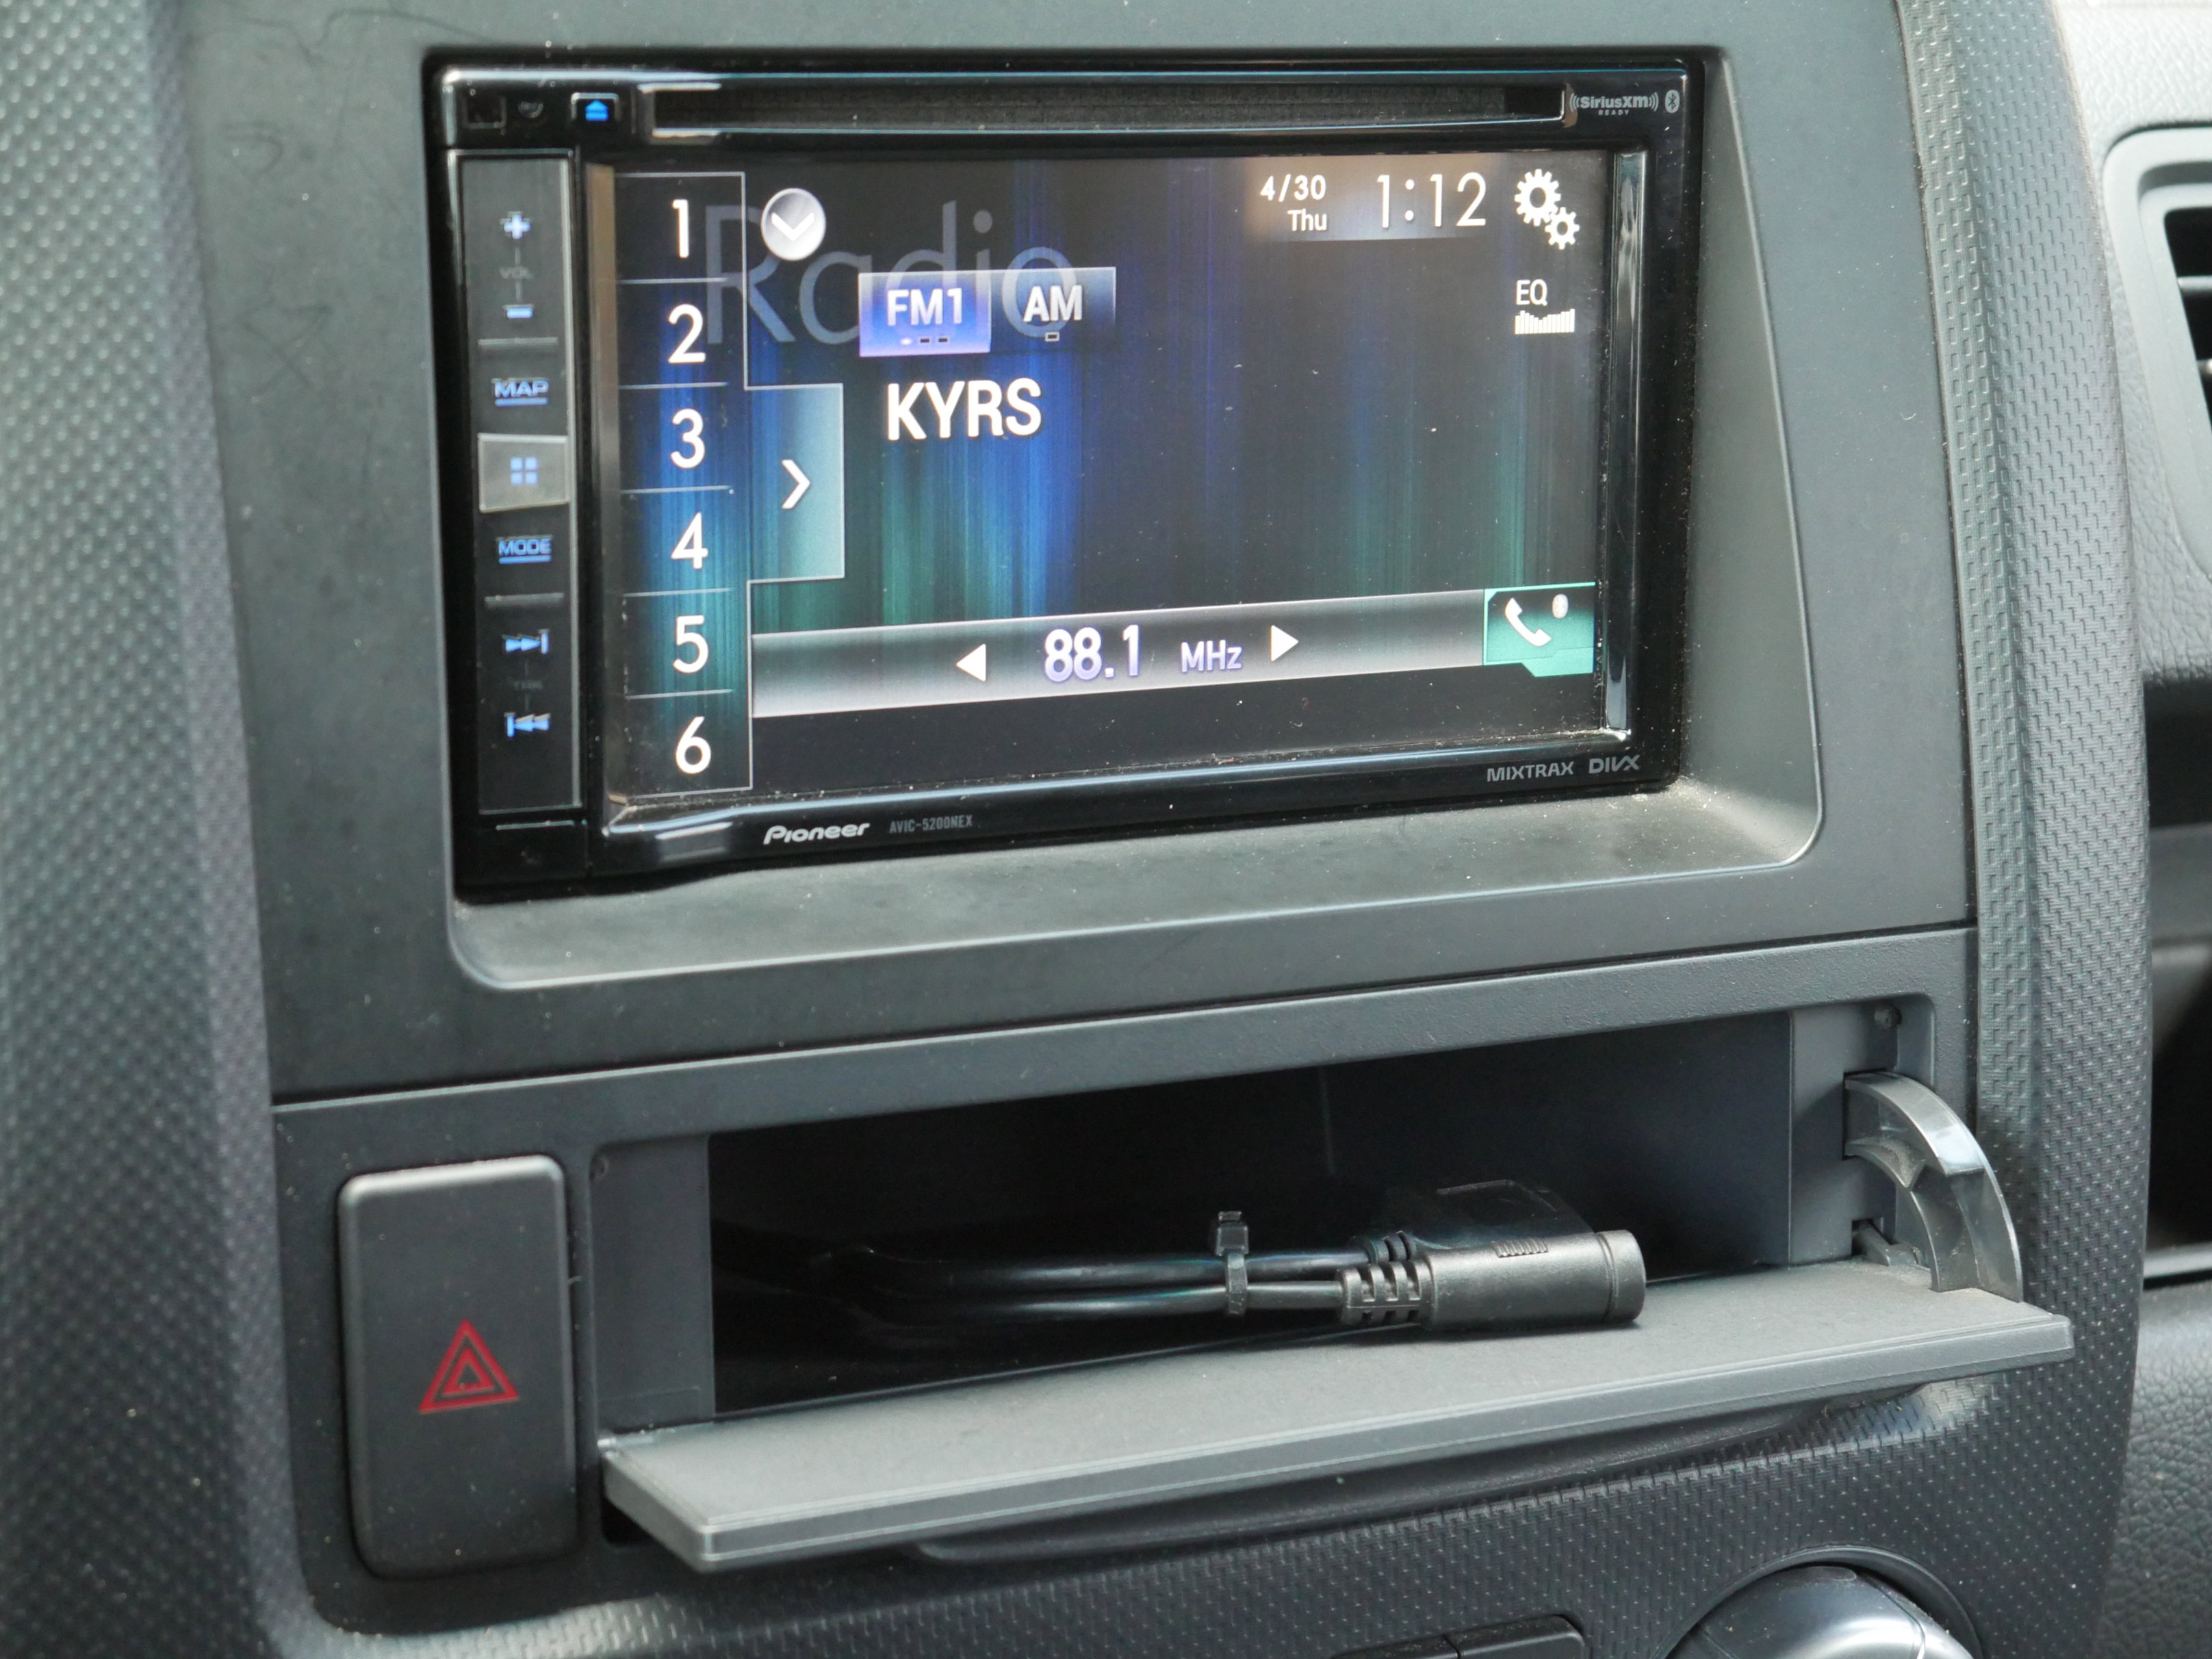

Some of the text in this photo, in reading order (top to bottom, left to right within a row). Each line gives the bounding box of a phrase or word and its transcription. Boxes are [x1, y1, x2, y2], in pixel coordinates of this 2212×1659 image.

[1260, 174, 1326, 203] 4/30
[1376, 172, 1487, 229] 1:12
[671, 198, 690, 259] 1
[1287, 209, 1328, 232] Thu
[705, 200, 1079, 345] Radio
[1515, 279, 1549, 307] EQ
[886, 287, 964, 326] FM1
[1023, 285, 1083, 322] AM
[667, 303, 707, 364] 2
[493, 378, 550, 398] MAP
[887, 376, 1042, 441] KYRS
[671, 408, 706, 470] 3
[498, 537, 553, 556] MODE
[670, 511, 709, 570] 4
[672, 615, 710, 674] 5
[1044, 623, 1244, 683] 88.1 MHz
[675, 715, 712, 775] 6
[1486, 761, 1575, 783] MIXTRAX
[762, 822, 871, 845] Pioneer
[889, 814, 974, 835] AVIC-5200NEX
